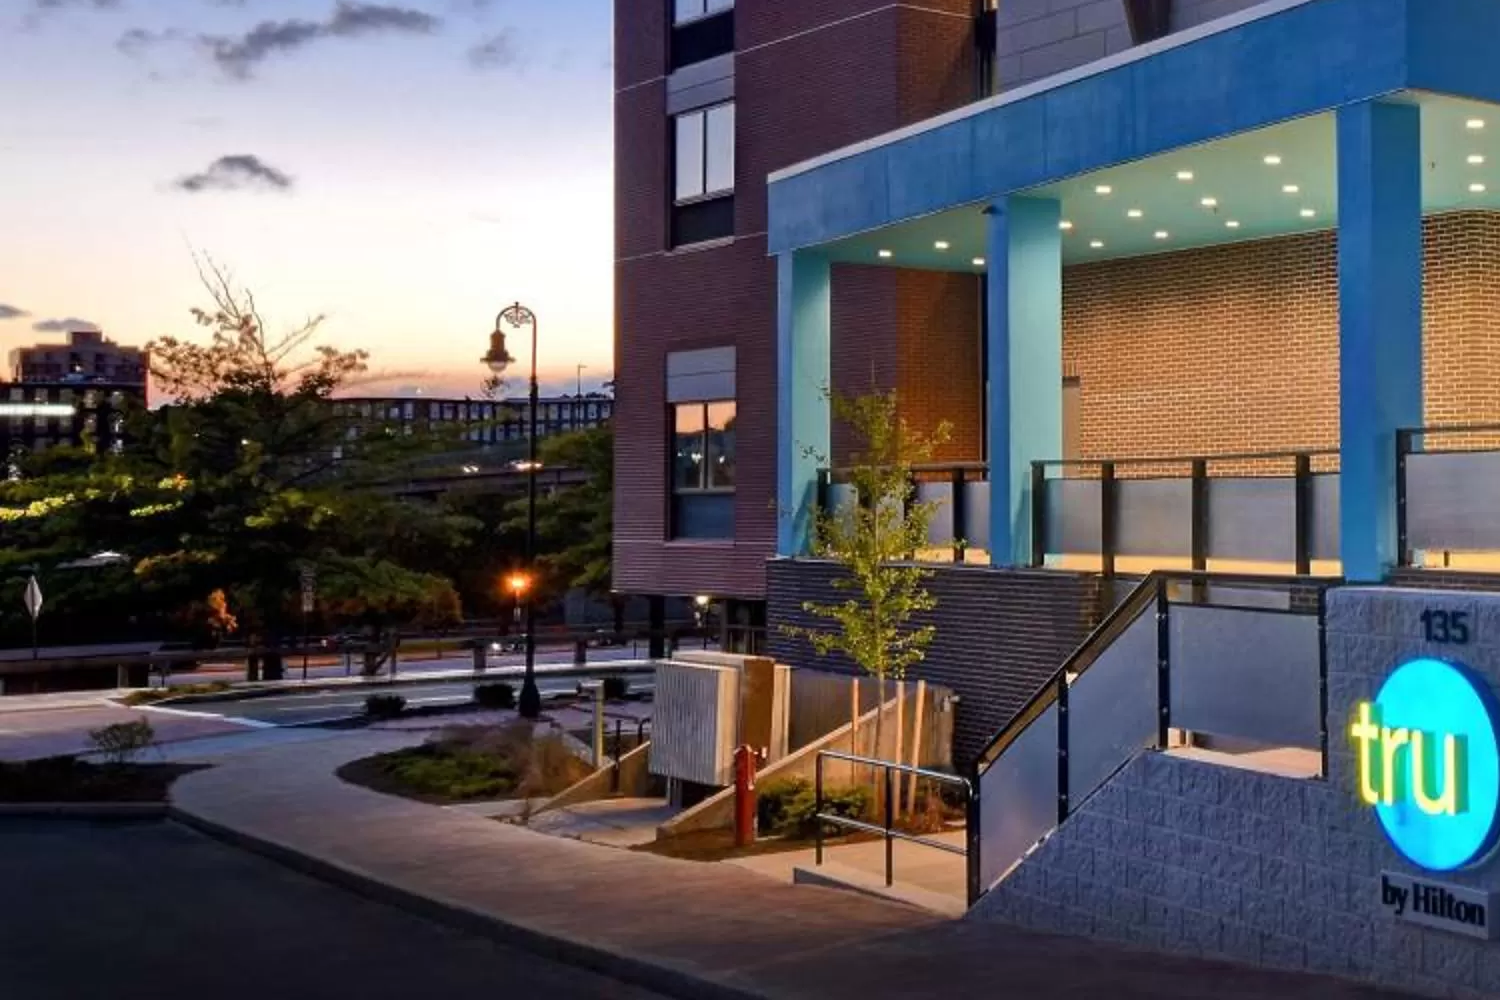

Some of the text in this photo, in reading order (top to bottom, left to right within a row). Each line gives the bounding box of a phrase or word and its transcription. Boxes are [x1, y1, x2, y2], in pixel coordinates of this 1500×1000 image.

[1420, 608, 1468, 644] 135
[1351, 702, 1460, 816] tru
[1381, 875, 1486, 927] by Hilton
